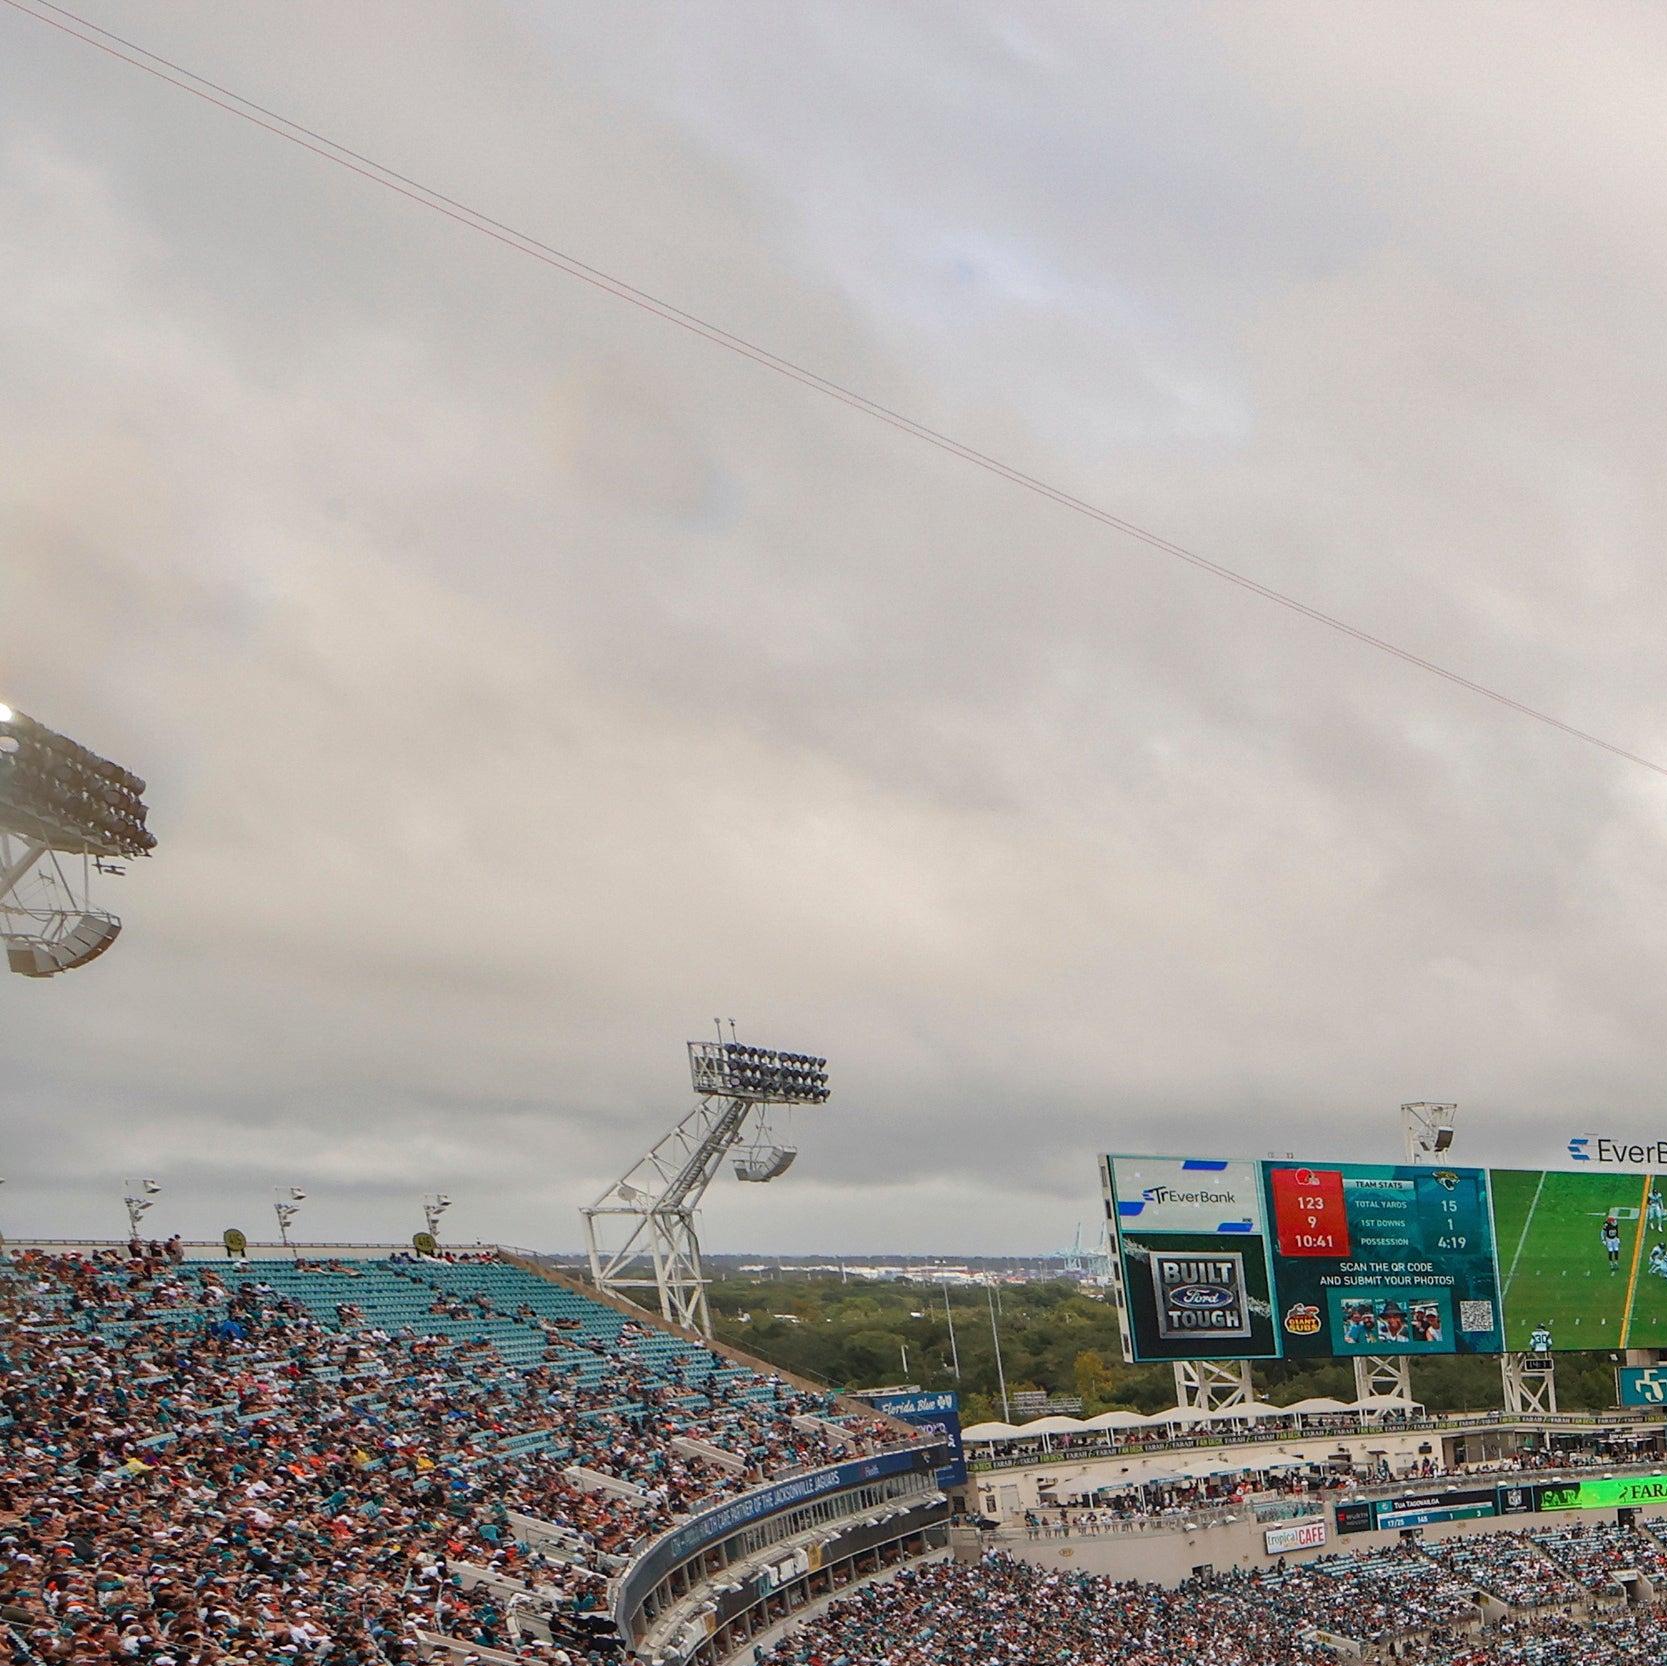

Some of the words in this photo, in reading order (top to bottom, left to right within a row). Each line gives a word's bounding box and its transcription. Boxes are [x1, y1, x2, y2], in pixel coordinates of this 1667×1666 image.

[1170, 1190, 1235, 1203] EverBank
[1298, 1197, 1324, 1210] 123
[1381, 1201, 1407, 1209] YARDS
[1441, 1200, 1457, 1212] 15
[1308, 1217, 1317, 1228] 9
[1447, 1219, 1453, 1230] 1
[1296, 1235, 1333, 1247] 10:41
[1361, 1238, 1408, 1246] POSSESSION
[1438, 1237, 1466, 1249] 4:19
[1163, 1262, 1232, 1283] BUILT
[1340, 1263, 1366, 1272] SCAN
[1370, 1263, 1388, 1271] THE
[1391, 1263, 1405, 1272] QR
[1407, 1263, 1433, 1271] CODE
[1320, 1277, 1341, 1285] AND
[1344, 1277, 1382, 1285] SUBMIT
[1384, 1277, 1412, 1285] YOUR
[1414, 1277, 1455, 1285] PHOTOS!
[1184, 1290, 1219, 1303] Ford
[1168, 1310, 1239, 1328] TOUGH
[882, 1400, 916, 1415] Florida
[917, 1398, 936, 1412] Blue
[754, 1500, 763, 1513] OF
[763, 1496, 774, 1509] THE
[774, 1478, 814, 1507] JACKSONVILLE
[813, 1470, 840, 1492] JAGUARS
[1394, 1502, 1406, 1510] TUA
[1268, 1530, 1298, 1545] tropical
[1299, 1527, 1323, 1544] CAFE
